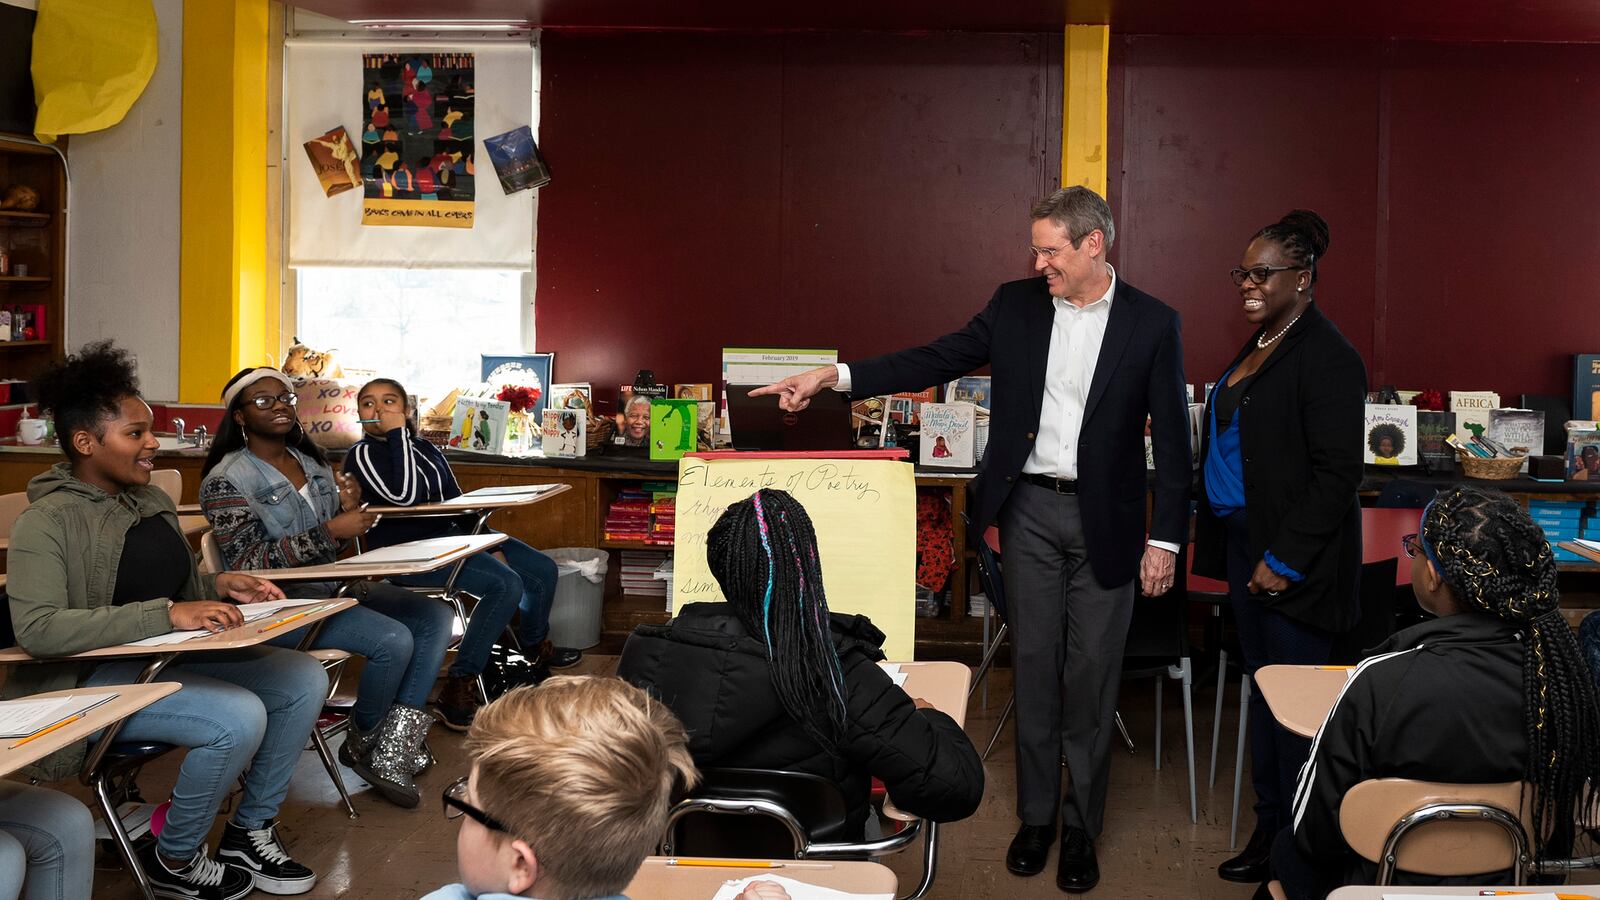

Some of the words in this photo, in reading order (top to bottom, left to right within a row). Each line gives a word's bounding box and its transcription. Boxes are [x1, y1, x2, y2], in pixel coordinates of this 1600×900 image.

[425, 209, 442, 218] ALL
[317, 388, 341, 399] XO
[343, 389, 358, 399] X
[1456, 397, 1494, 409] AFRICA
[323, 404, 358, 416] LOVE
[309, 420, 333, 433] XO
[679, 464, 776, 488] Elements
[785, 470, 805, 494] of
[805, 463, 881, 504] Poetry
